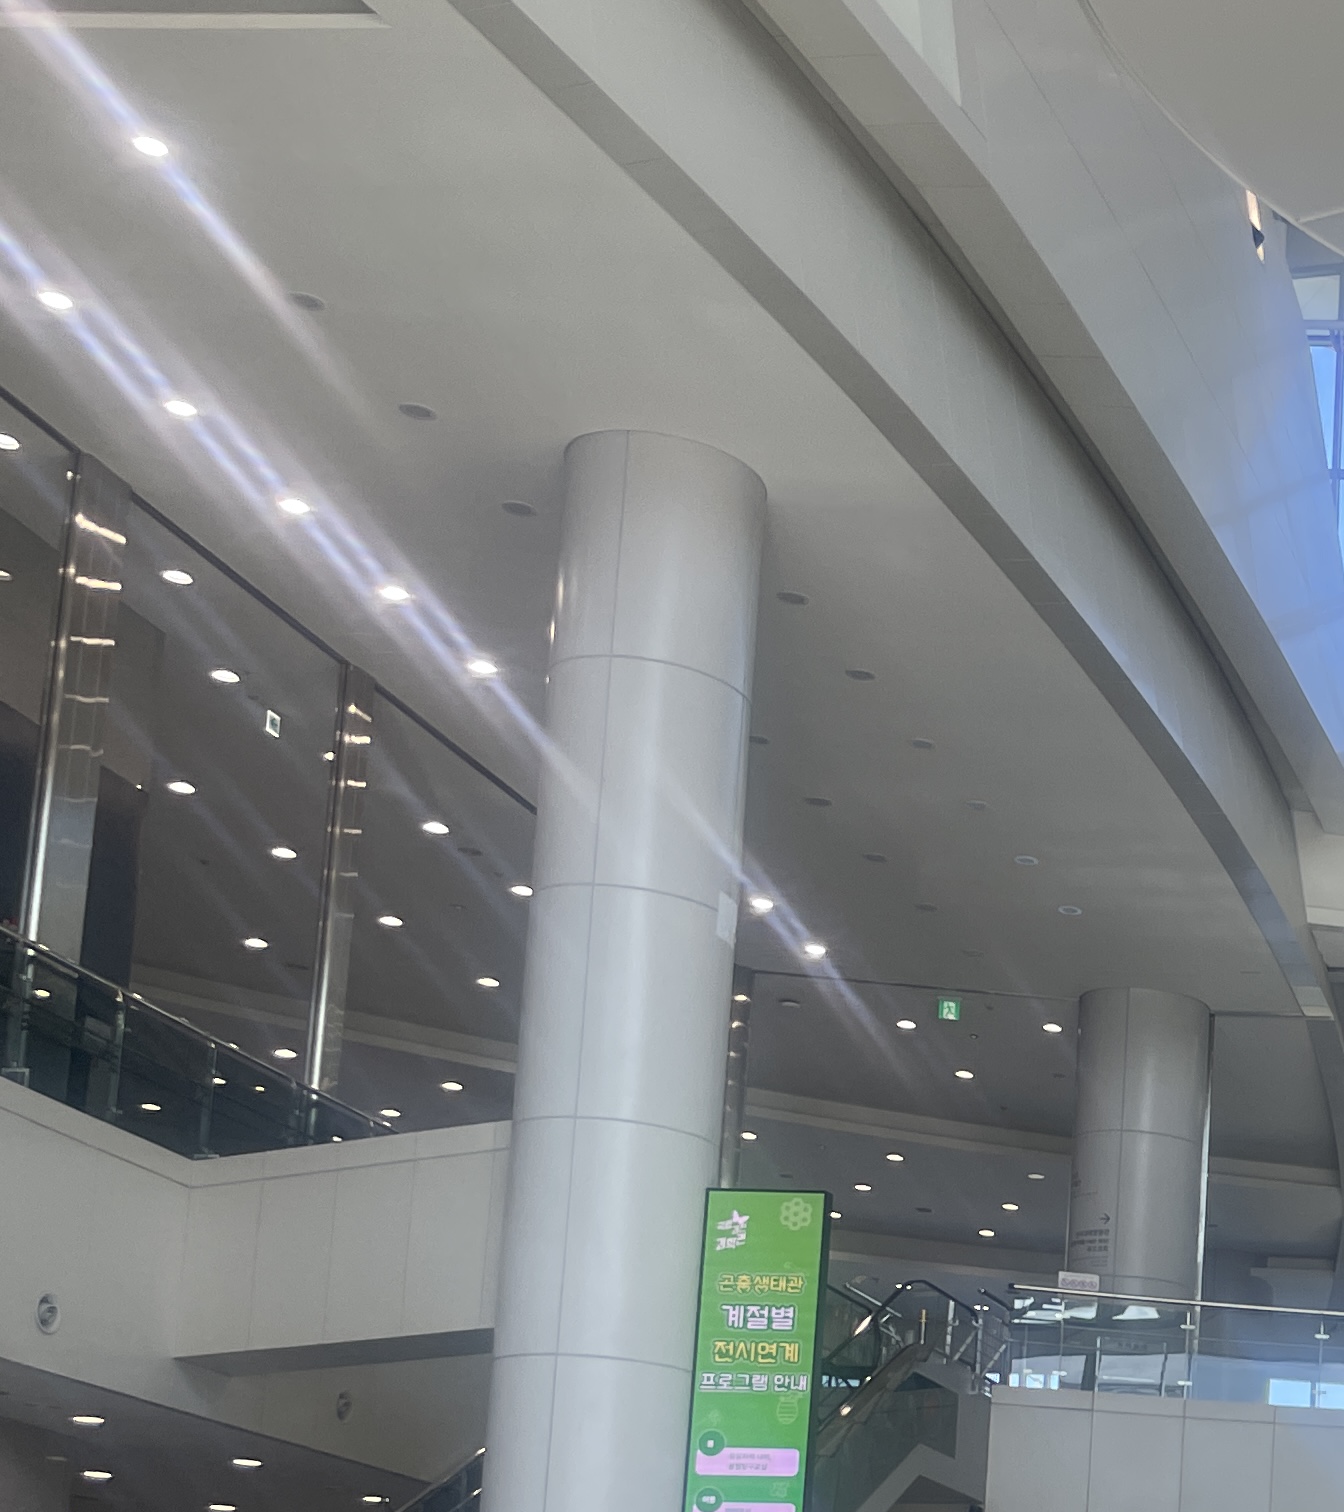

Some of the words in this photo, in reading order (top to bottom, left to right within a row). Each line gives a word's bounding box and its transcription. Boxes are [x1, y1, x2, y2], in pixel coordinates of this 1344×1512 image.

[718, 1274, 804, 1294] 곤충생태관
[721, 1304, 795, 1330] 계절별
[713, 1341, 799, 1363] 전시연계
[699, 1373, 768, 1391] 프로그램
[774, 1374, 808, 1391] 안내
